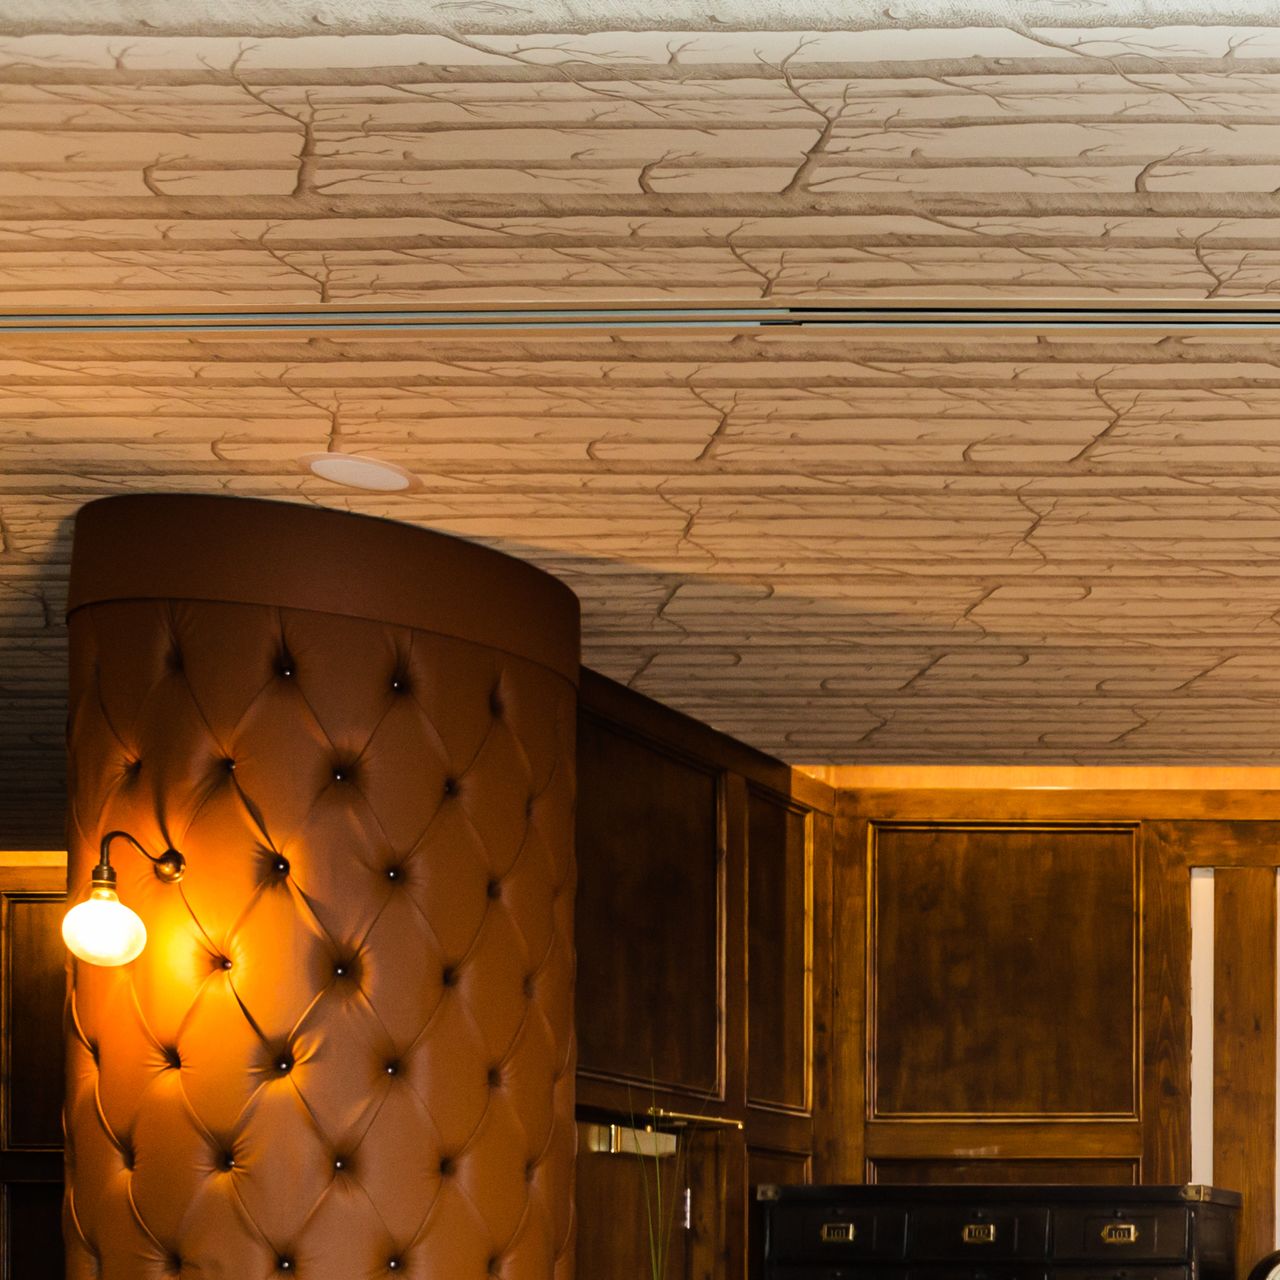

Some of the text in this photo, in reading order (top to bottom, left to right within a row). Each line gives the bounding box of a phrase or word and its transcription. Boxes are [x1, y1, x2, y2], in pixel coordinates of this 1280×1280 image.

[830, 1228, 847, 1239] 101
[970, 1226, 988, 1238] 102
[1111, 1229, 1129, 1240] 103
